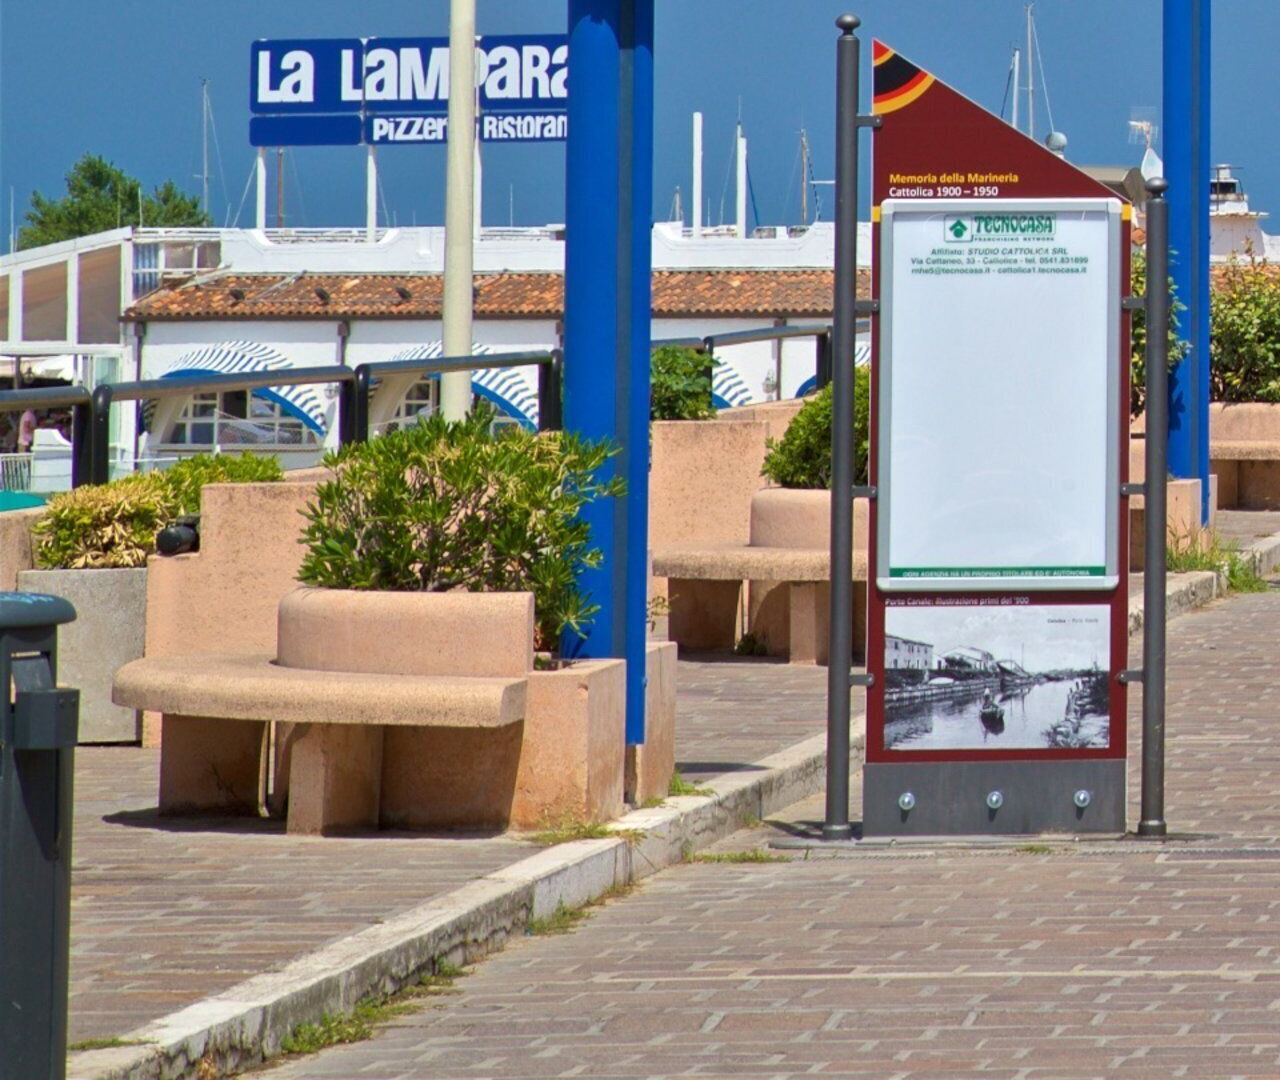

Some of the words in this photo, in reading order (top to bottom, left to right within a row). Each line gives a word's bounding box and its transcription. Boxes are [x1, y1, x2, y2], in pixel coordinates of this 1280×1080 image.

[889, 173, 937, 184] Memoria
[939, 172, 965, 184] della
[967, 172, 1019, 184] Marineria
[889, 187, 934, 197] Cattolica
[937, 186, 962, 197] 1900
[973, 186, 999, 197] 1950
[974, 216, 1053, 233] TECNOCASA
[967, 247, 999, 255] STUDIO
[1001, 247, 1050, 255] CATTOLICA
[1051, 247, 1068, 255] SRL
